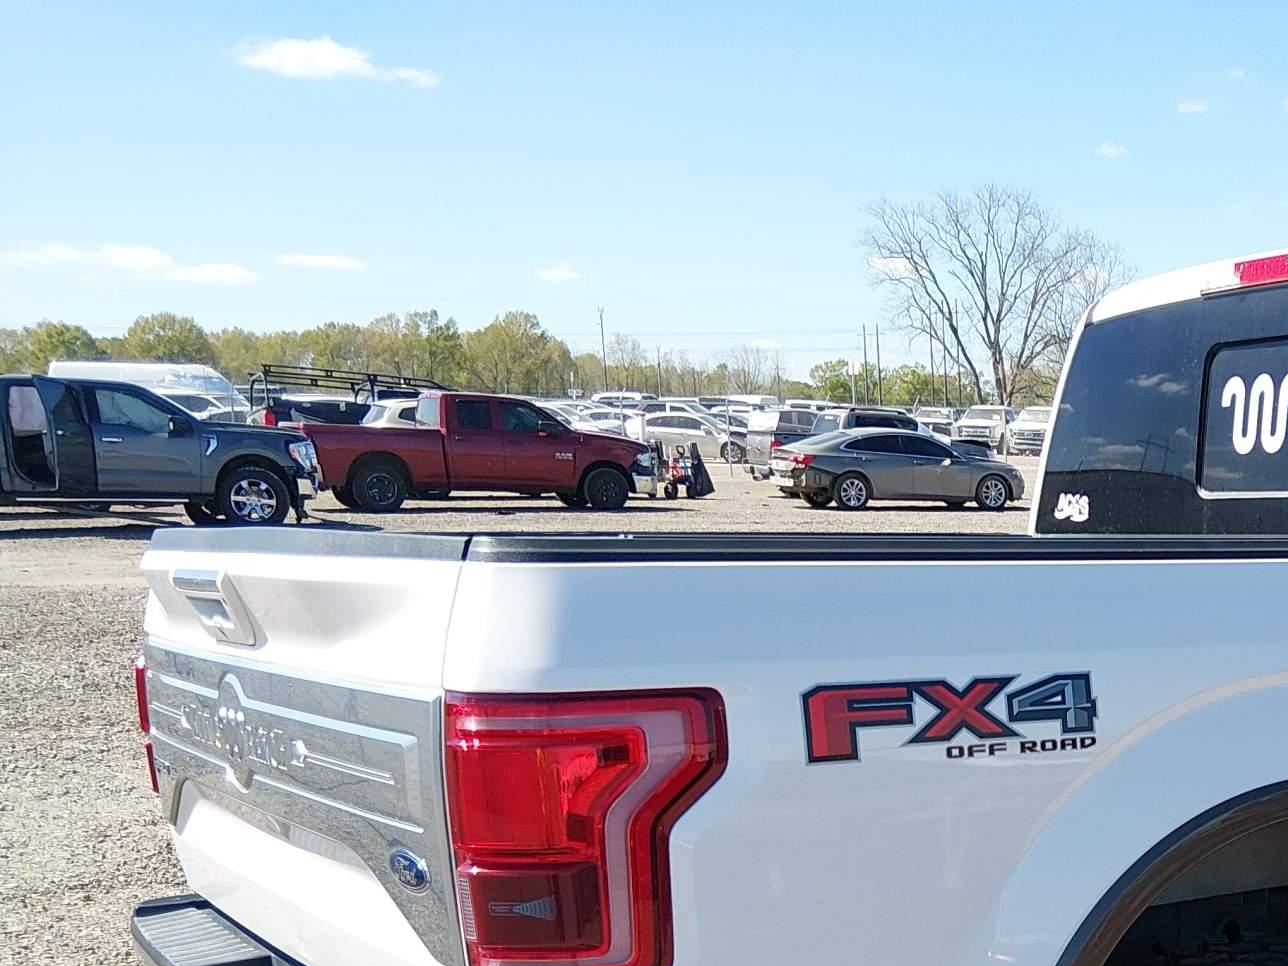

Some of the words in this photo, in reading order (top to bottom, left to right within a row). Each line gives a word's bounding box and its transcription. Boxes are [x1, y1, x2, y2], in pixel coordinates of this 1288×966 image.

[800, 671, 1098, 766] FX4
[946, 742, 1007, 759] OFF
[1020, 736, 1097, 754] ROAD
